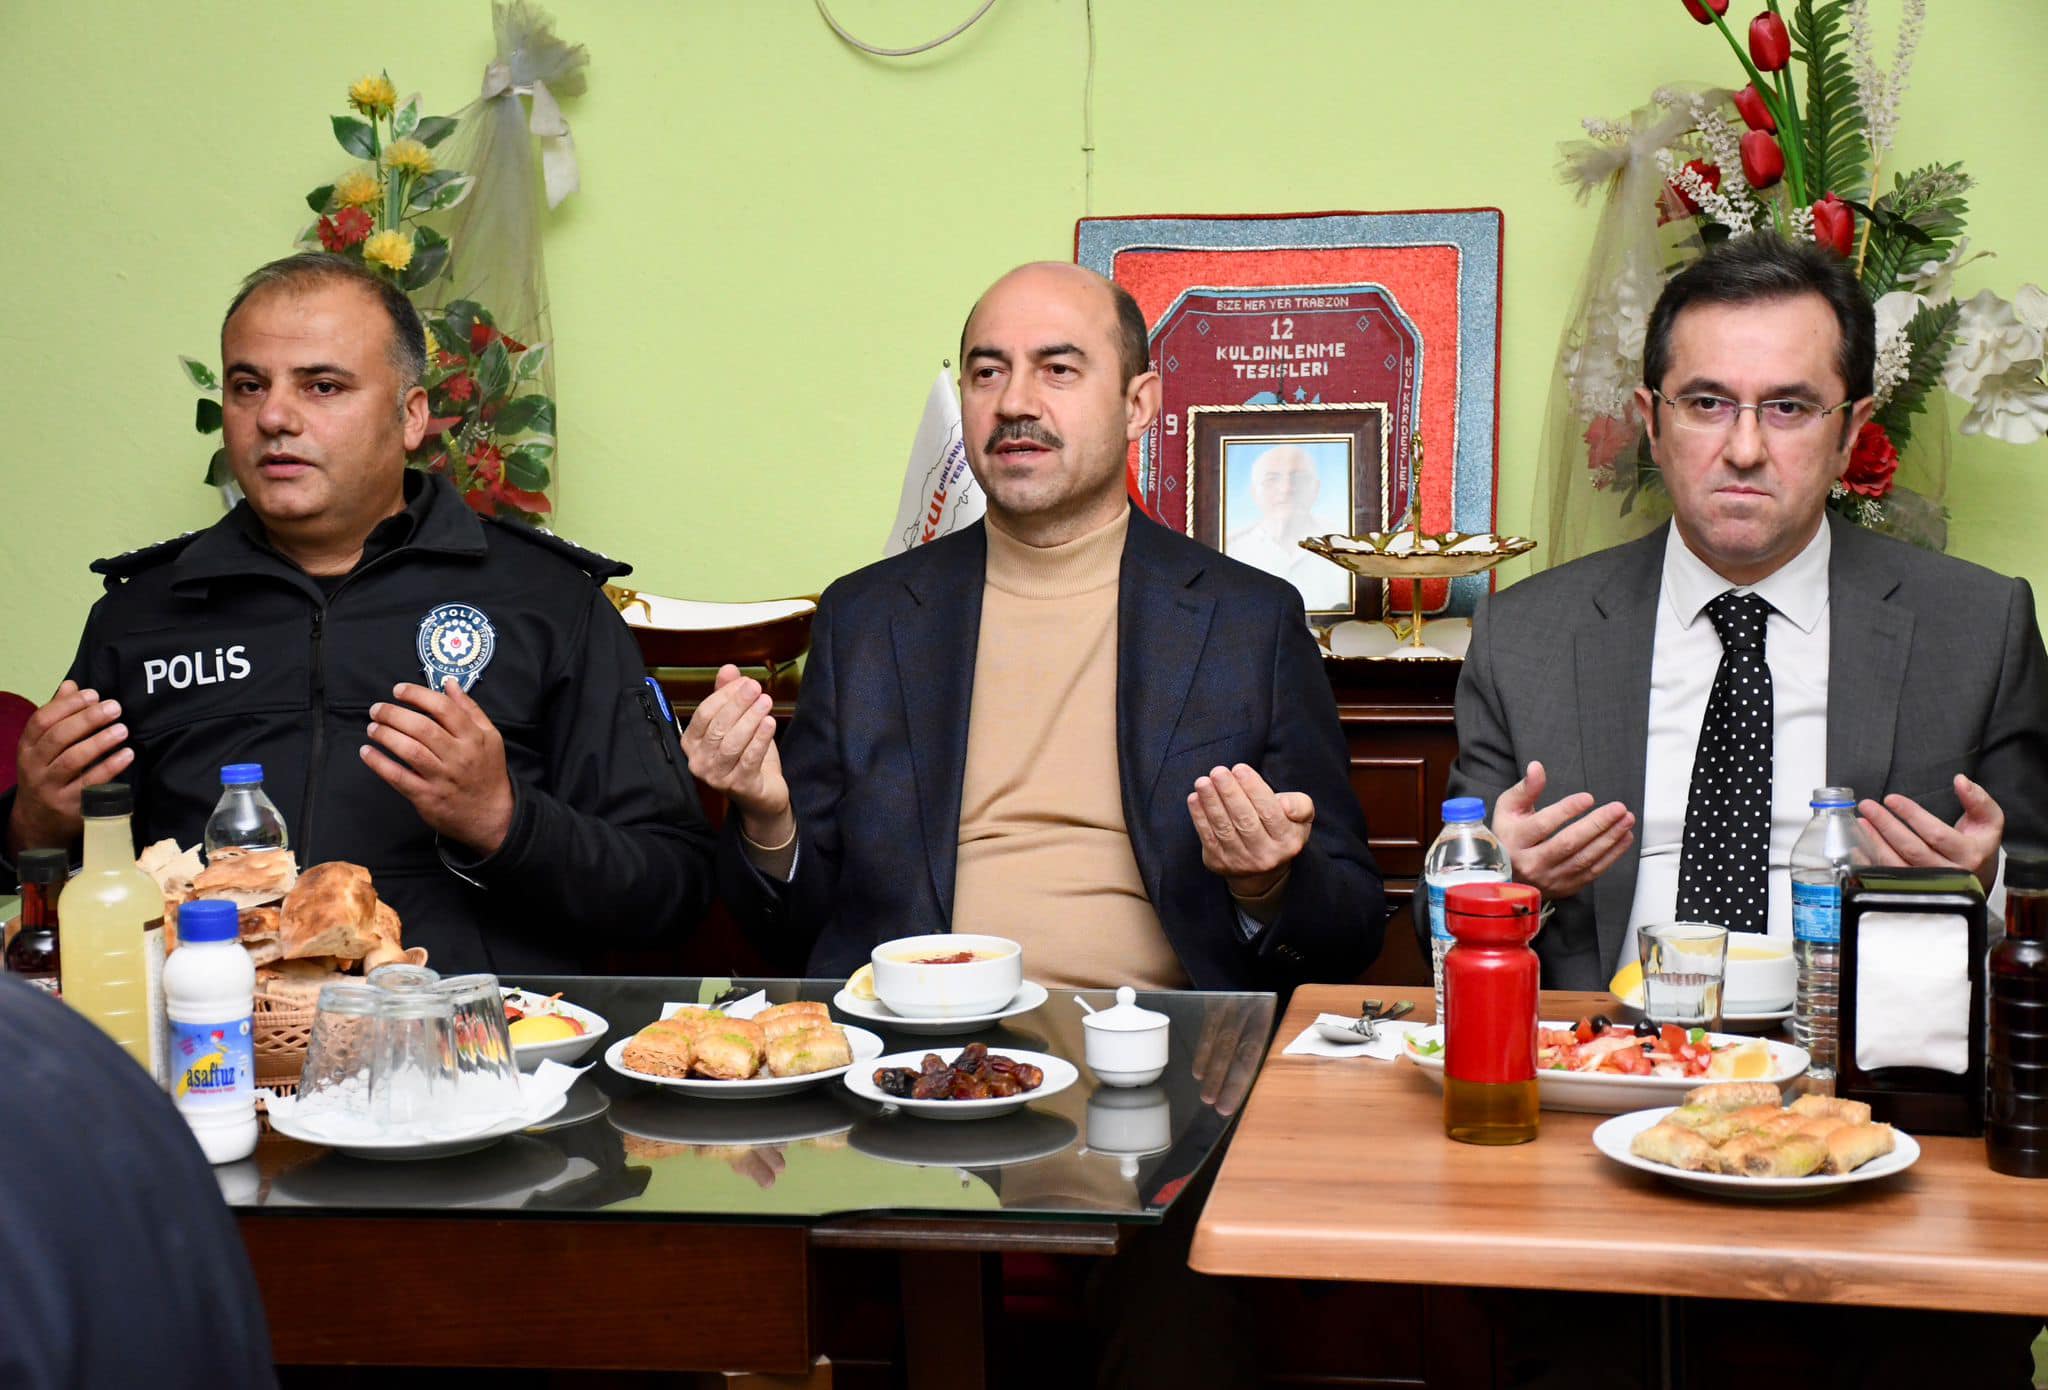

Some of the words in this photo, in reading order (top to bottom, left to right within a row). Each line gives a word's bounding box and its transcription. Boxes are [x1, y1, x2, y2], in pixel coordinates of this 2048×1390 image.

[1244, 298, 1266, 310] HER
[1269, 297, 1291, 309] YER
[1295, 296, 1349, 308] TRABZON
[1270, 317, 1294, 340] 12
[1165, 413, 1178, 435] 9
[921, 489, 948, 543] KUL
